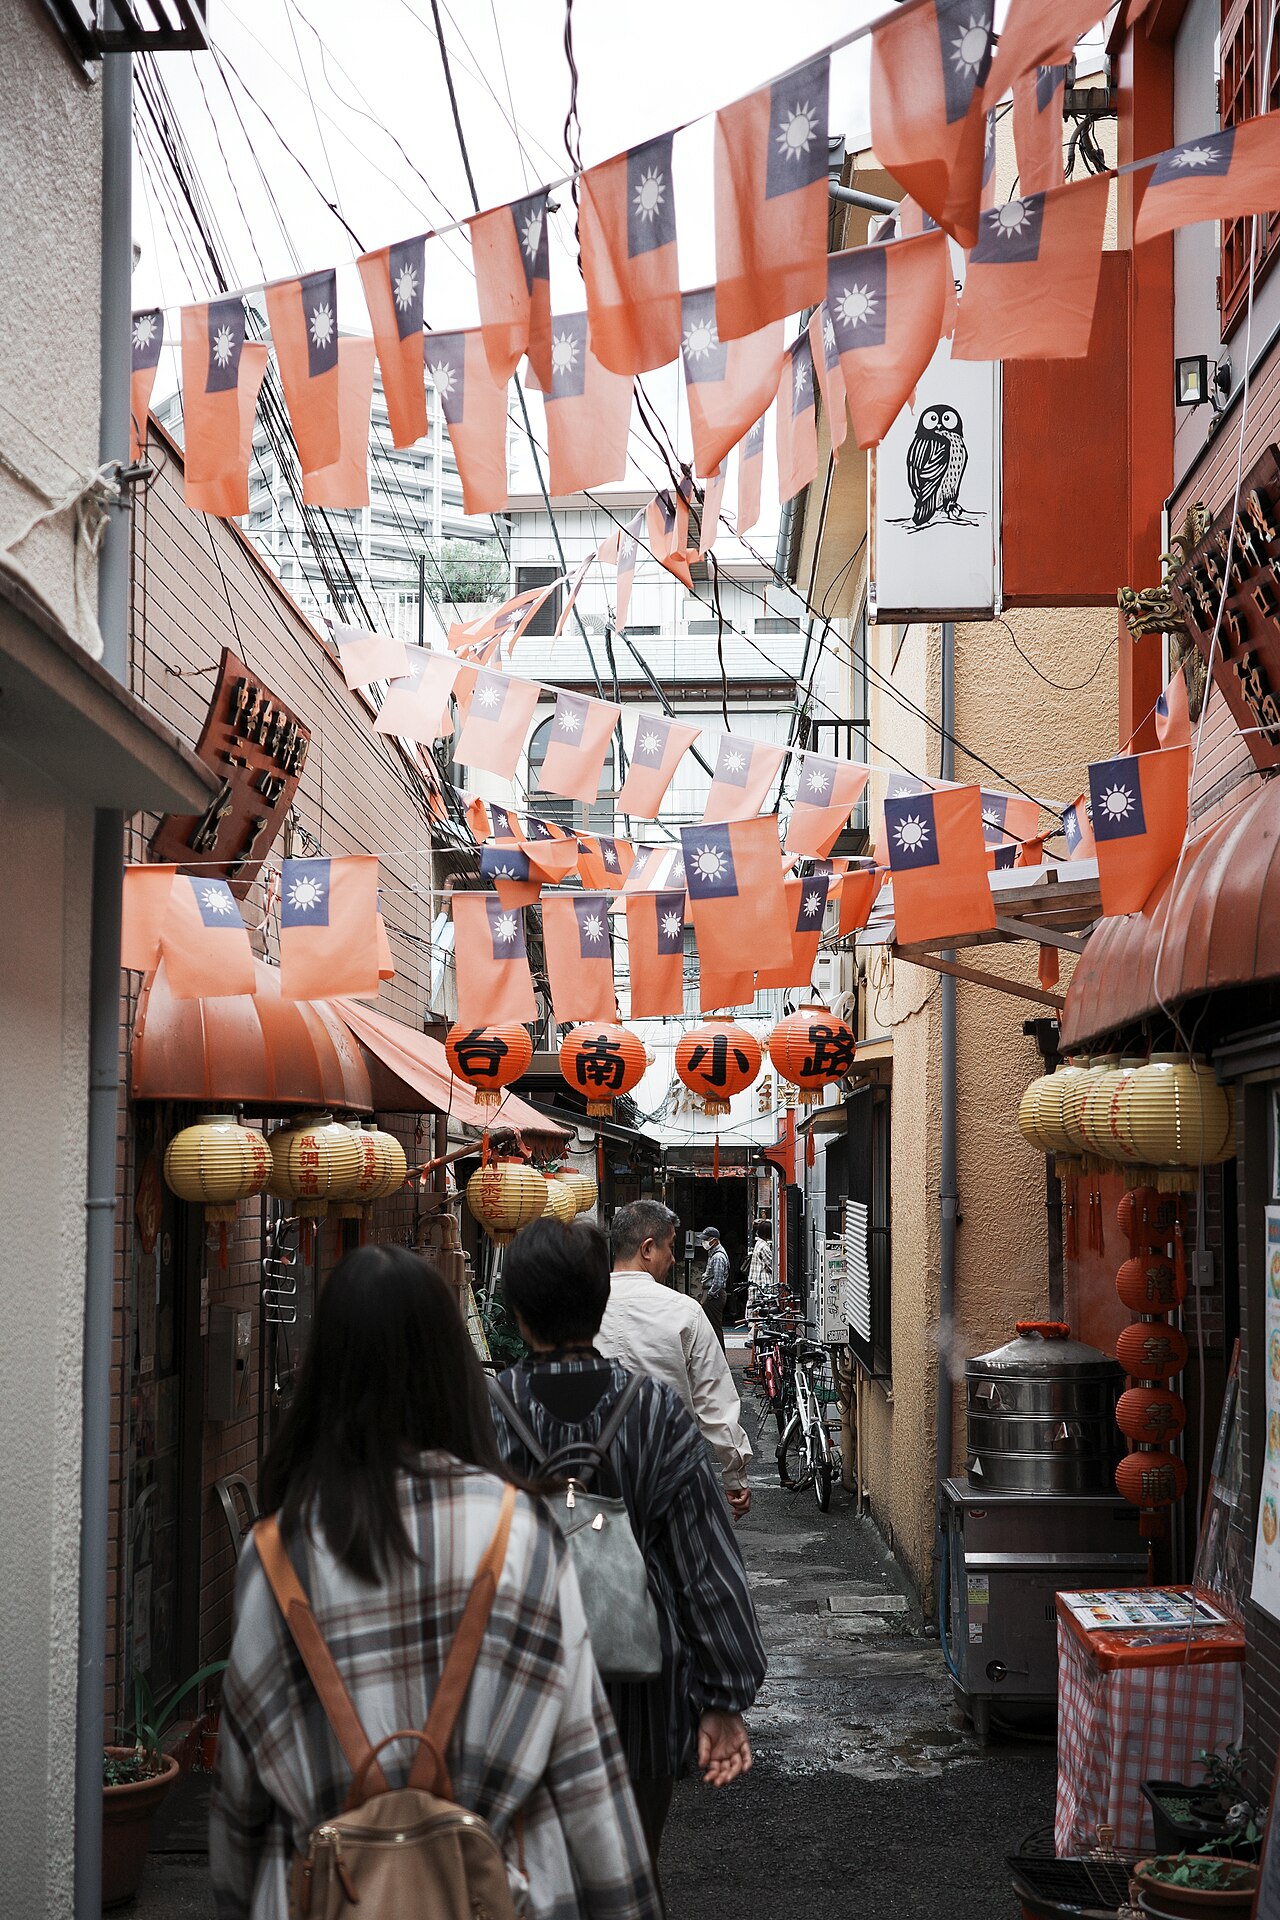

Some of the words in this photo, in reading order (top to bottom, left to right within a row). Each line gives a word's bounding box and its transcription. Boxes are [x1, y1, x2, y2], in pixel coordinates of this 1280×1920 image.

[454, 1025, 855, 1089] 台南小路
[480, 1173, 506, 1219] 國泰民安
